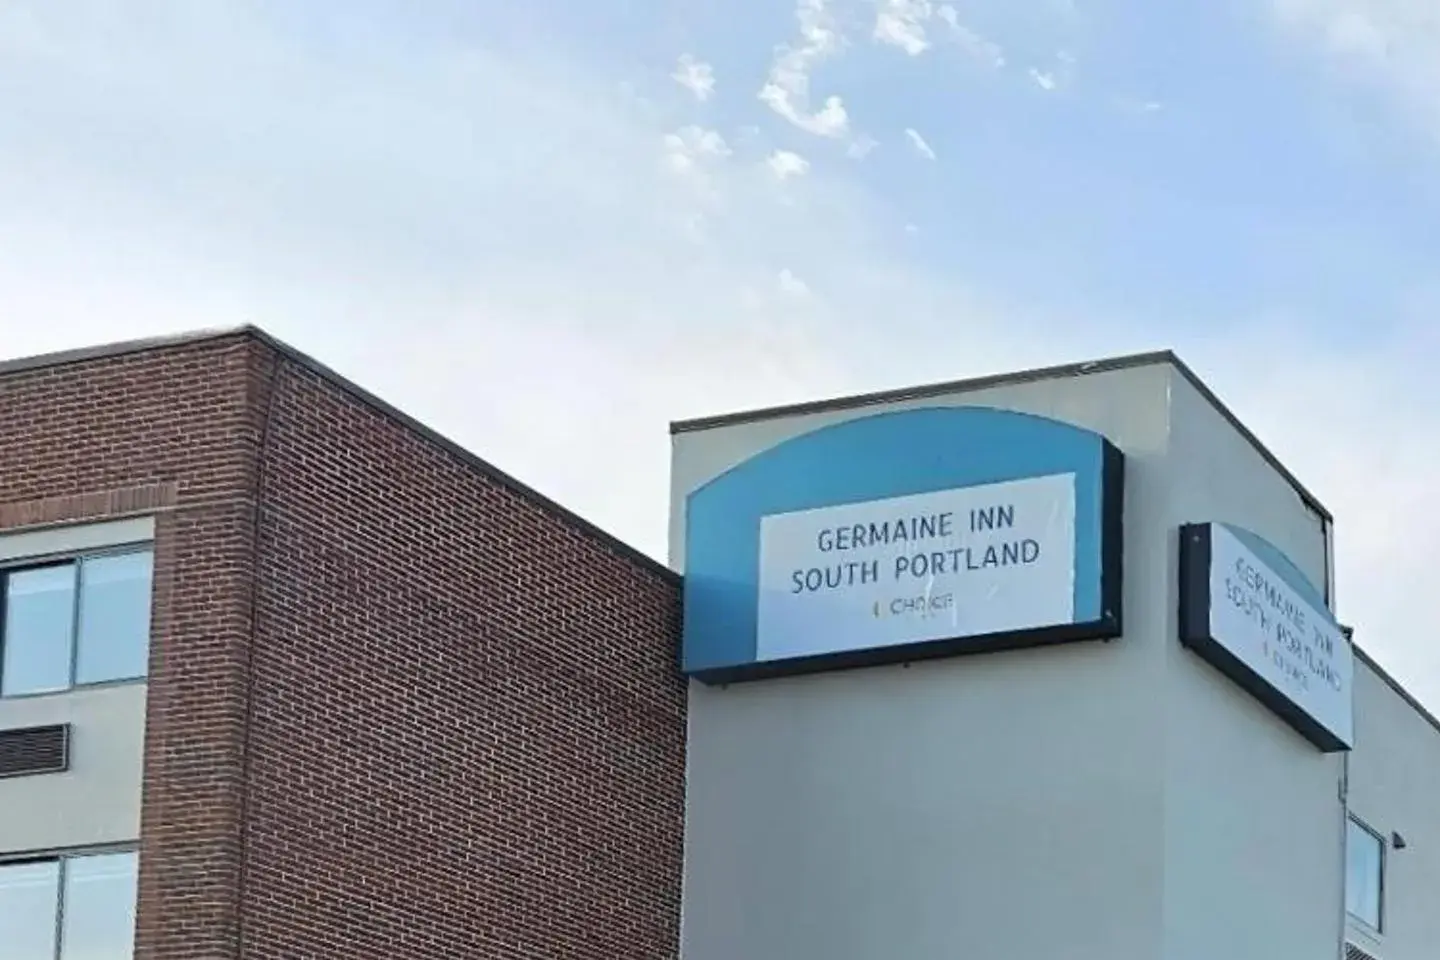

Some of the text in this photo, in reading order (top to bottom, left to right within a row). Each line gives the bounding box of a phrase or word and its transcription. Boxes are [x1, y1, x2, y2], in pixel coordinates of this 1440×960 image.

[818, 505, 1014, 552] GERMAINE INN
[792, 539, 1040, 594] SOUTH PORTLAND
